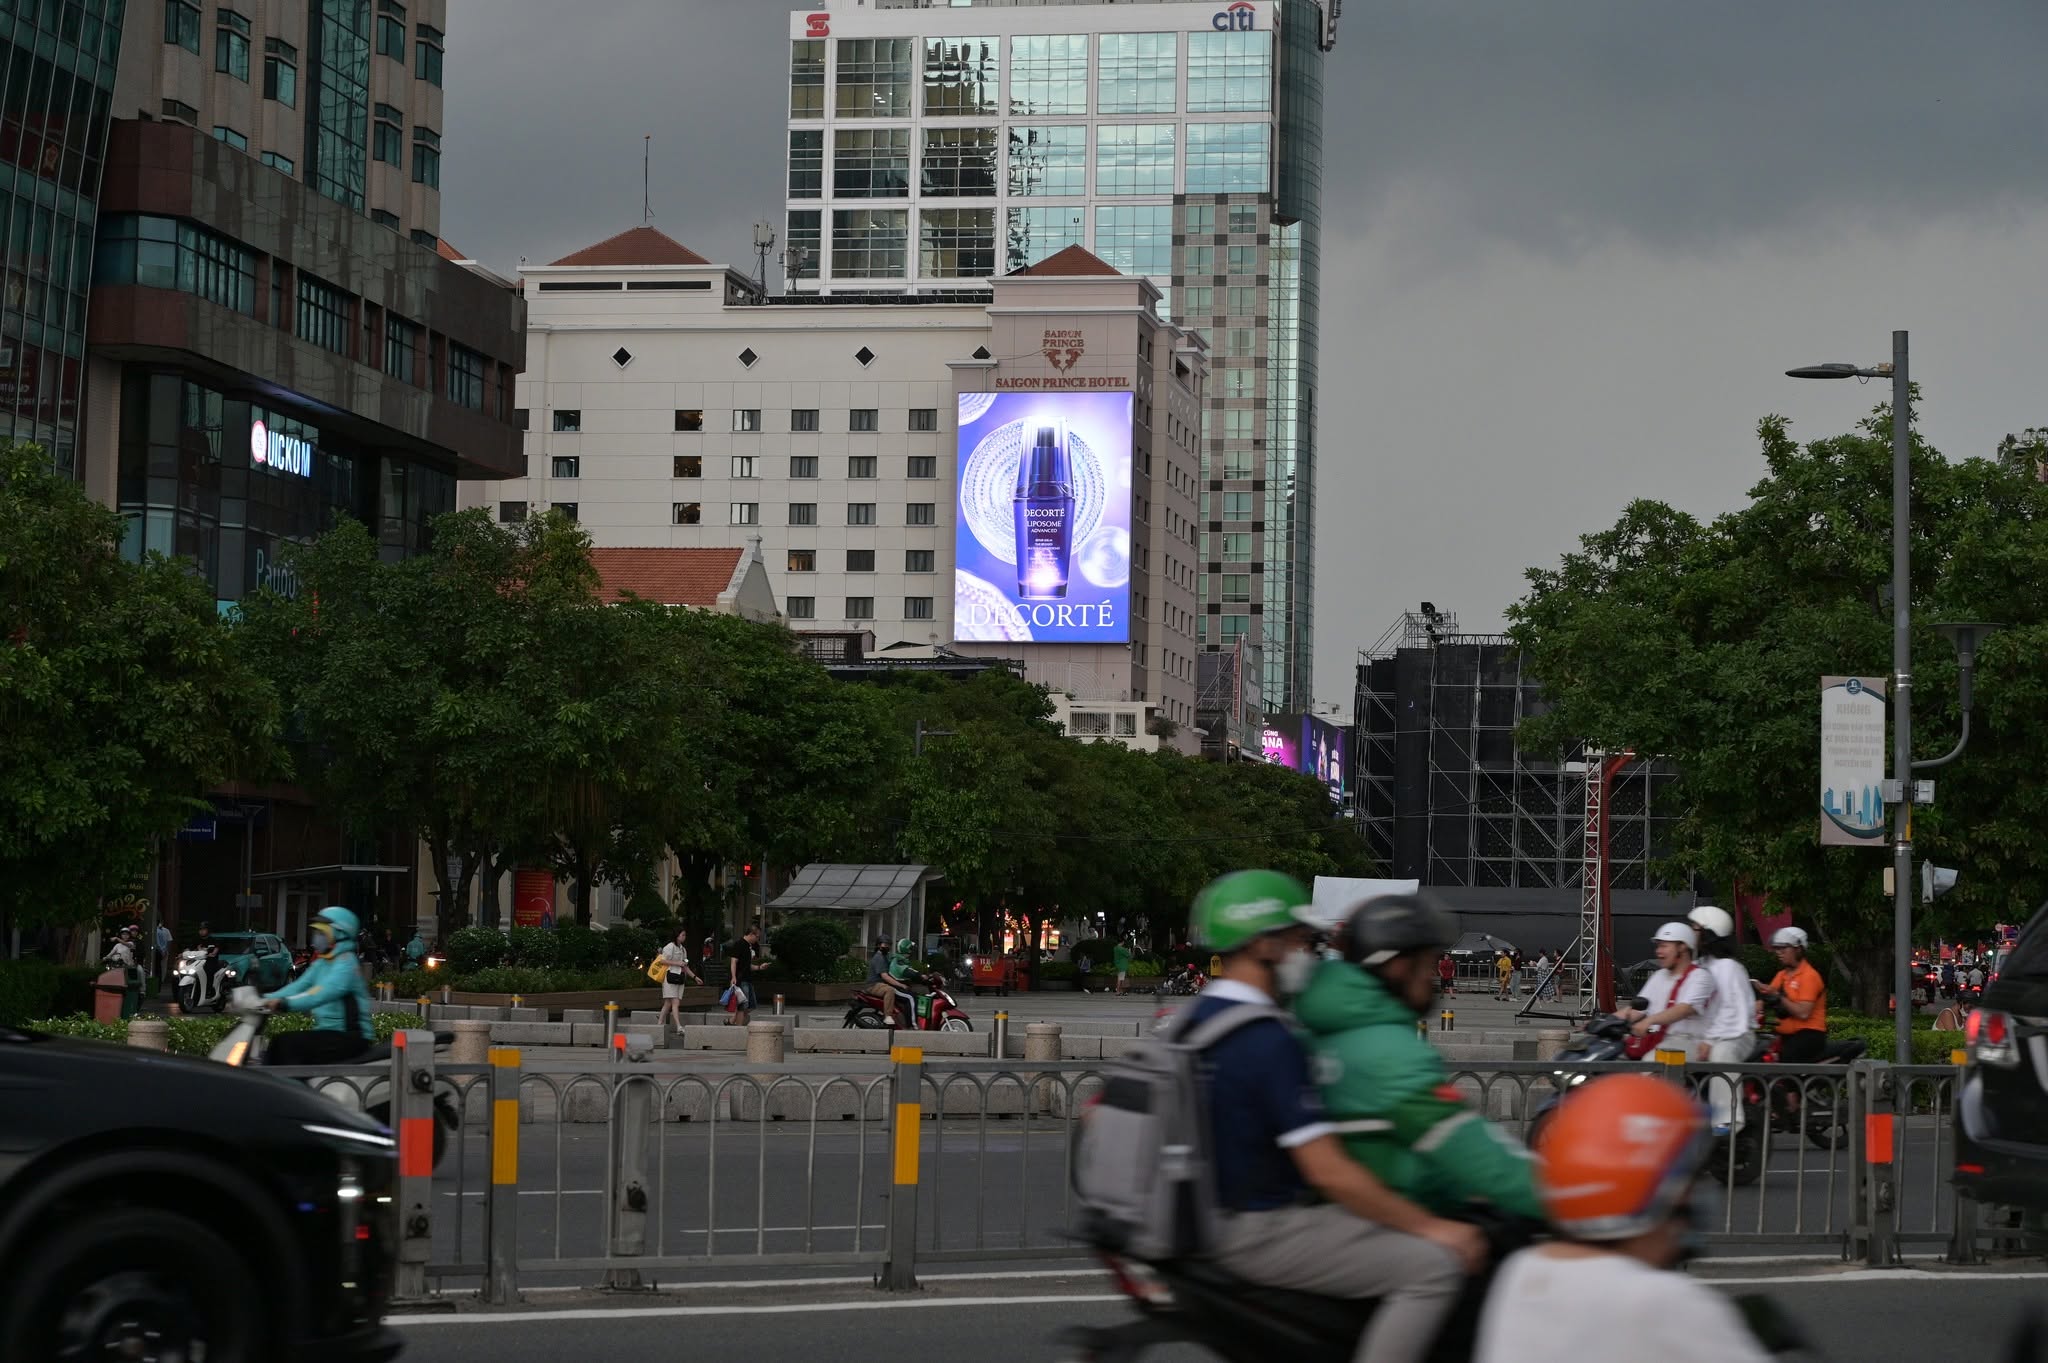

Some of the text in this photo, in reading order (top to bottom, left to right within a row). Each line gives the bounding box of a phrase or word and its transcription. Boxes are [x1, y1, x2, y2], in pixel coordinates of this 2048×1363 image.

[1213, 8, 1254, 31] citi
[1042, 339, 1084, 347] PRINCE
[996, 377, 1130, 388] SAIGON PRINCE HOTEL
[1024, 508, 1065, 517] DECORTÉ
[968, 600, 1115, 627] DECORTÉ
